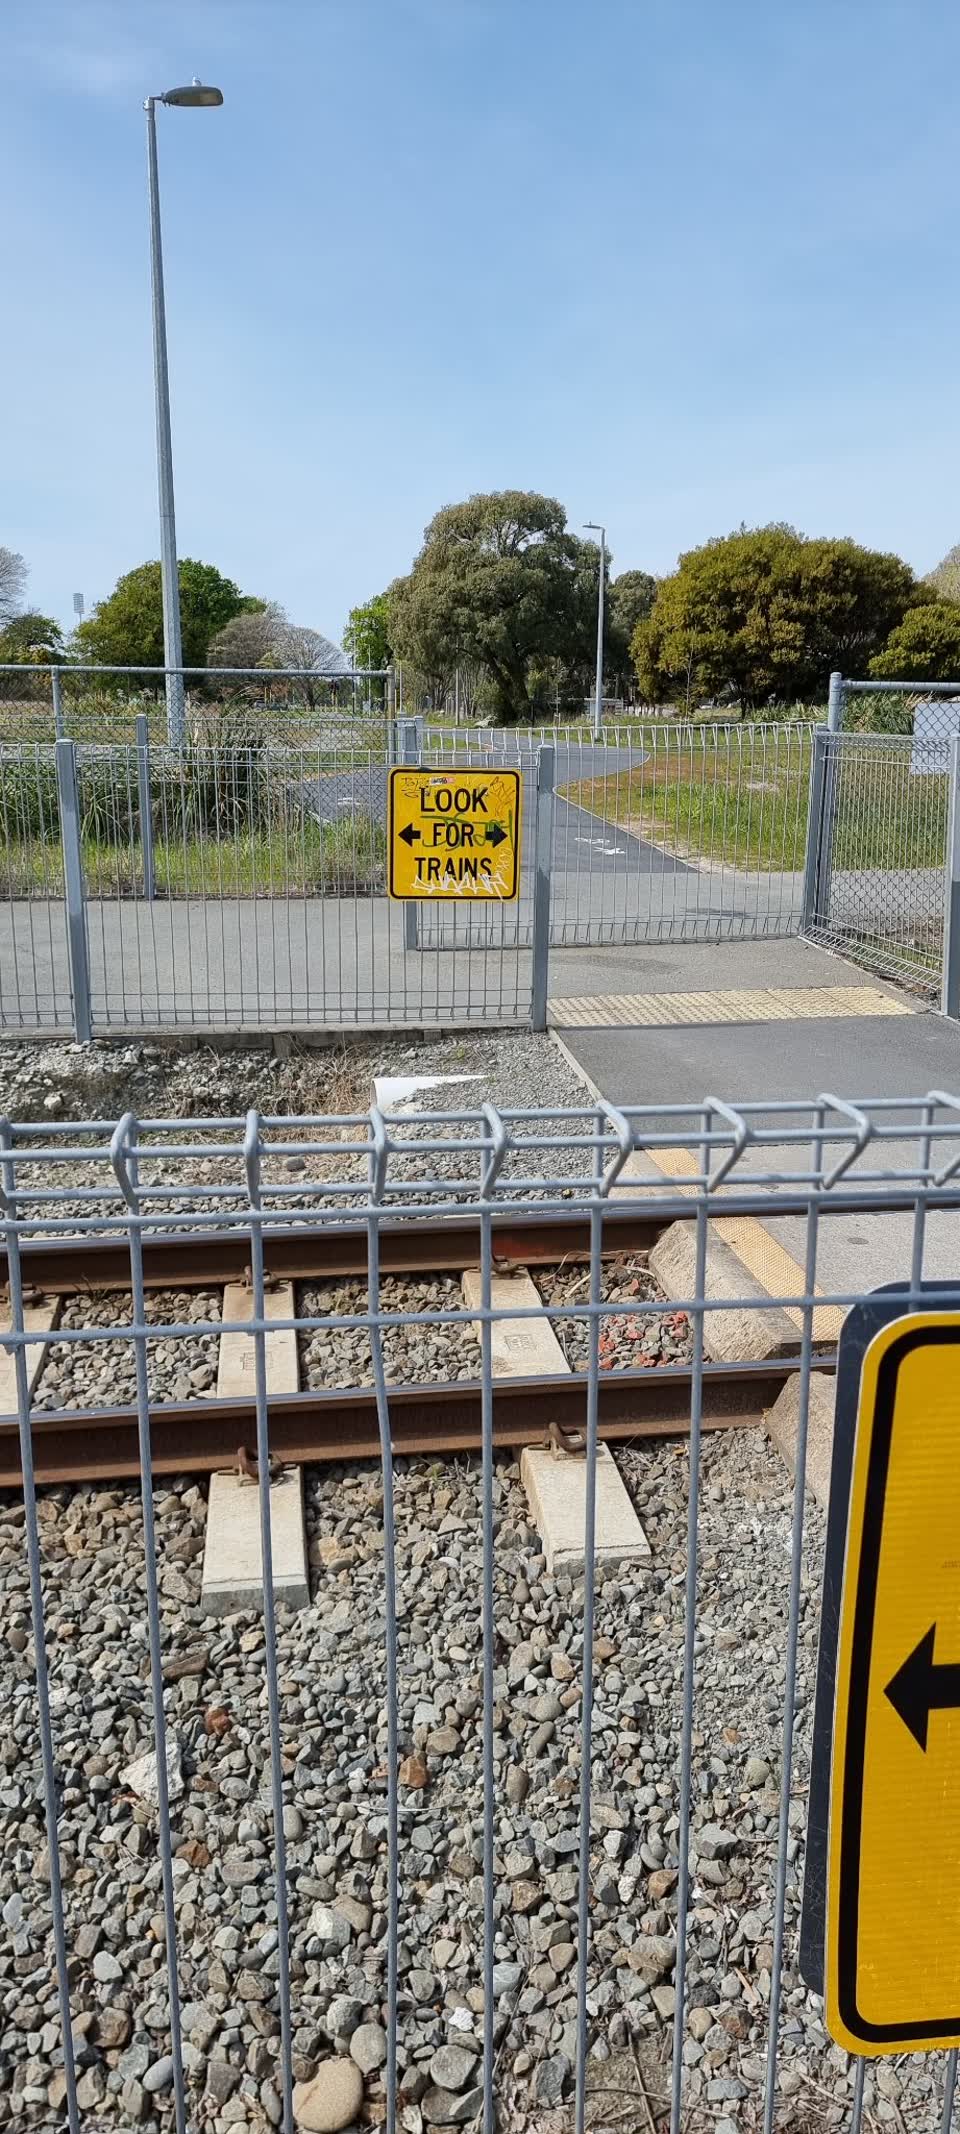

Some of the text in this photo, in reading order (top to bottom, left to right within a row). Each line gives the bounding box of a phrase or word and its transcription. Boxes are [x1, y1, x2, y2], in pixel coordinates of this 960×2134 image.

[420, 788, 488, 812] LOOK
[433, 823, 475, 847] FOR
[414, 857, 492, 881] TRAINS
